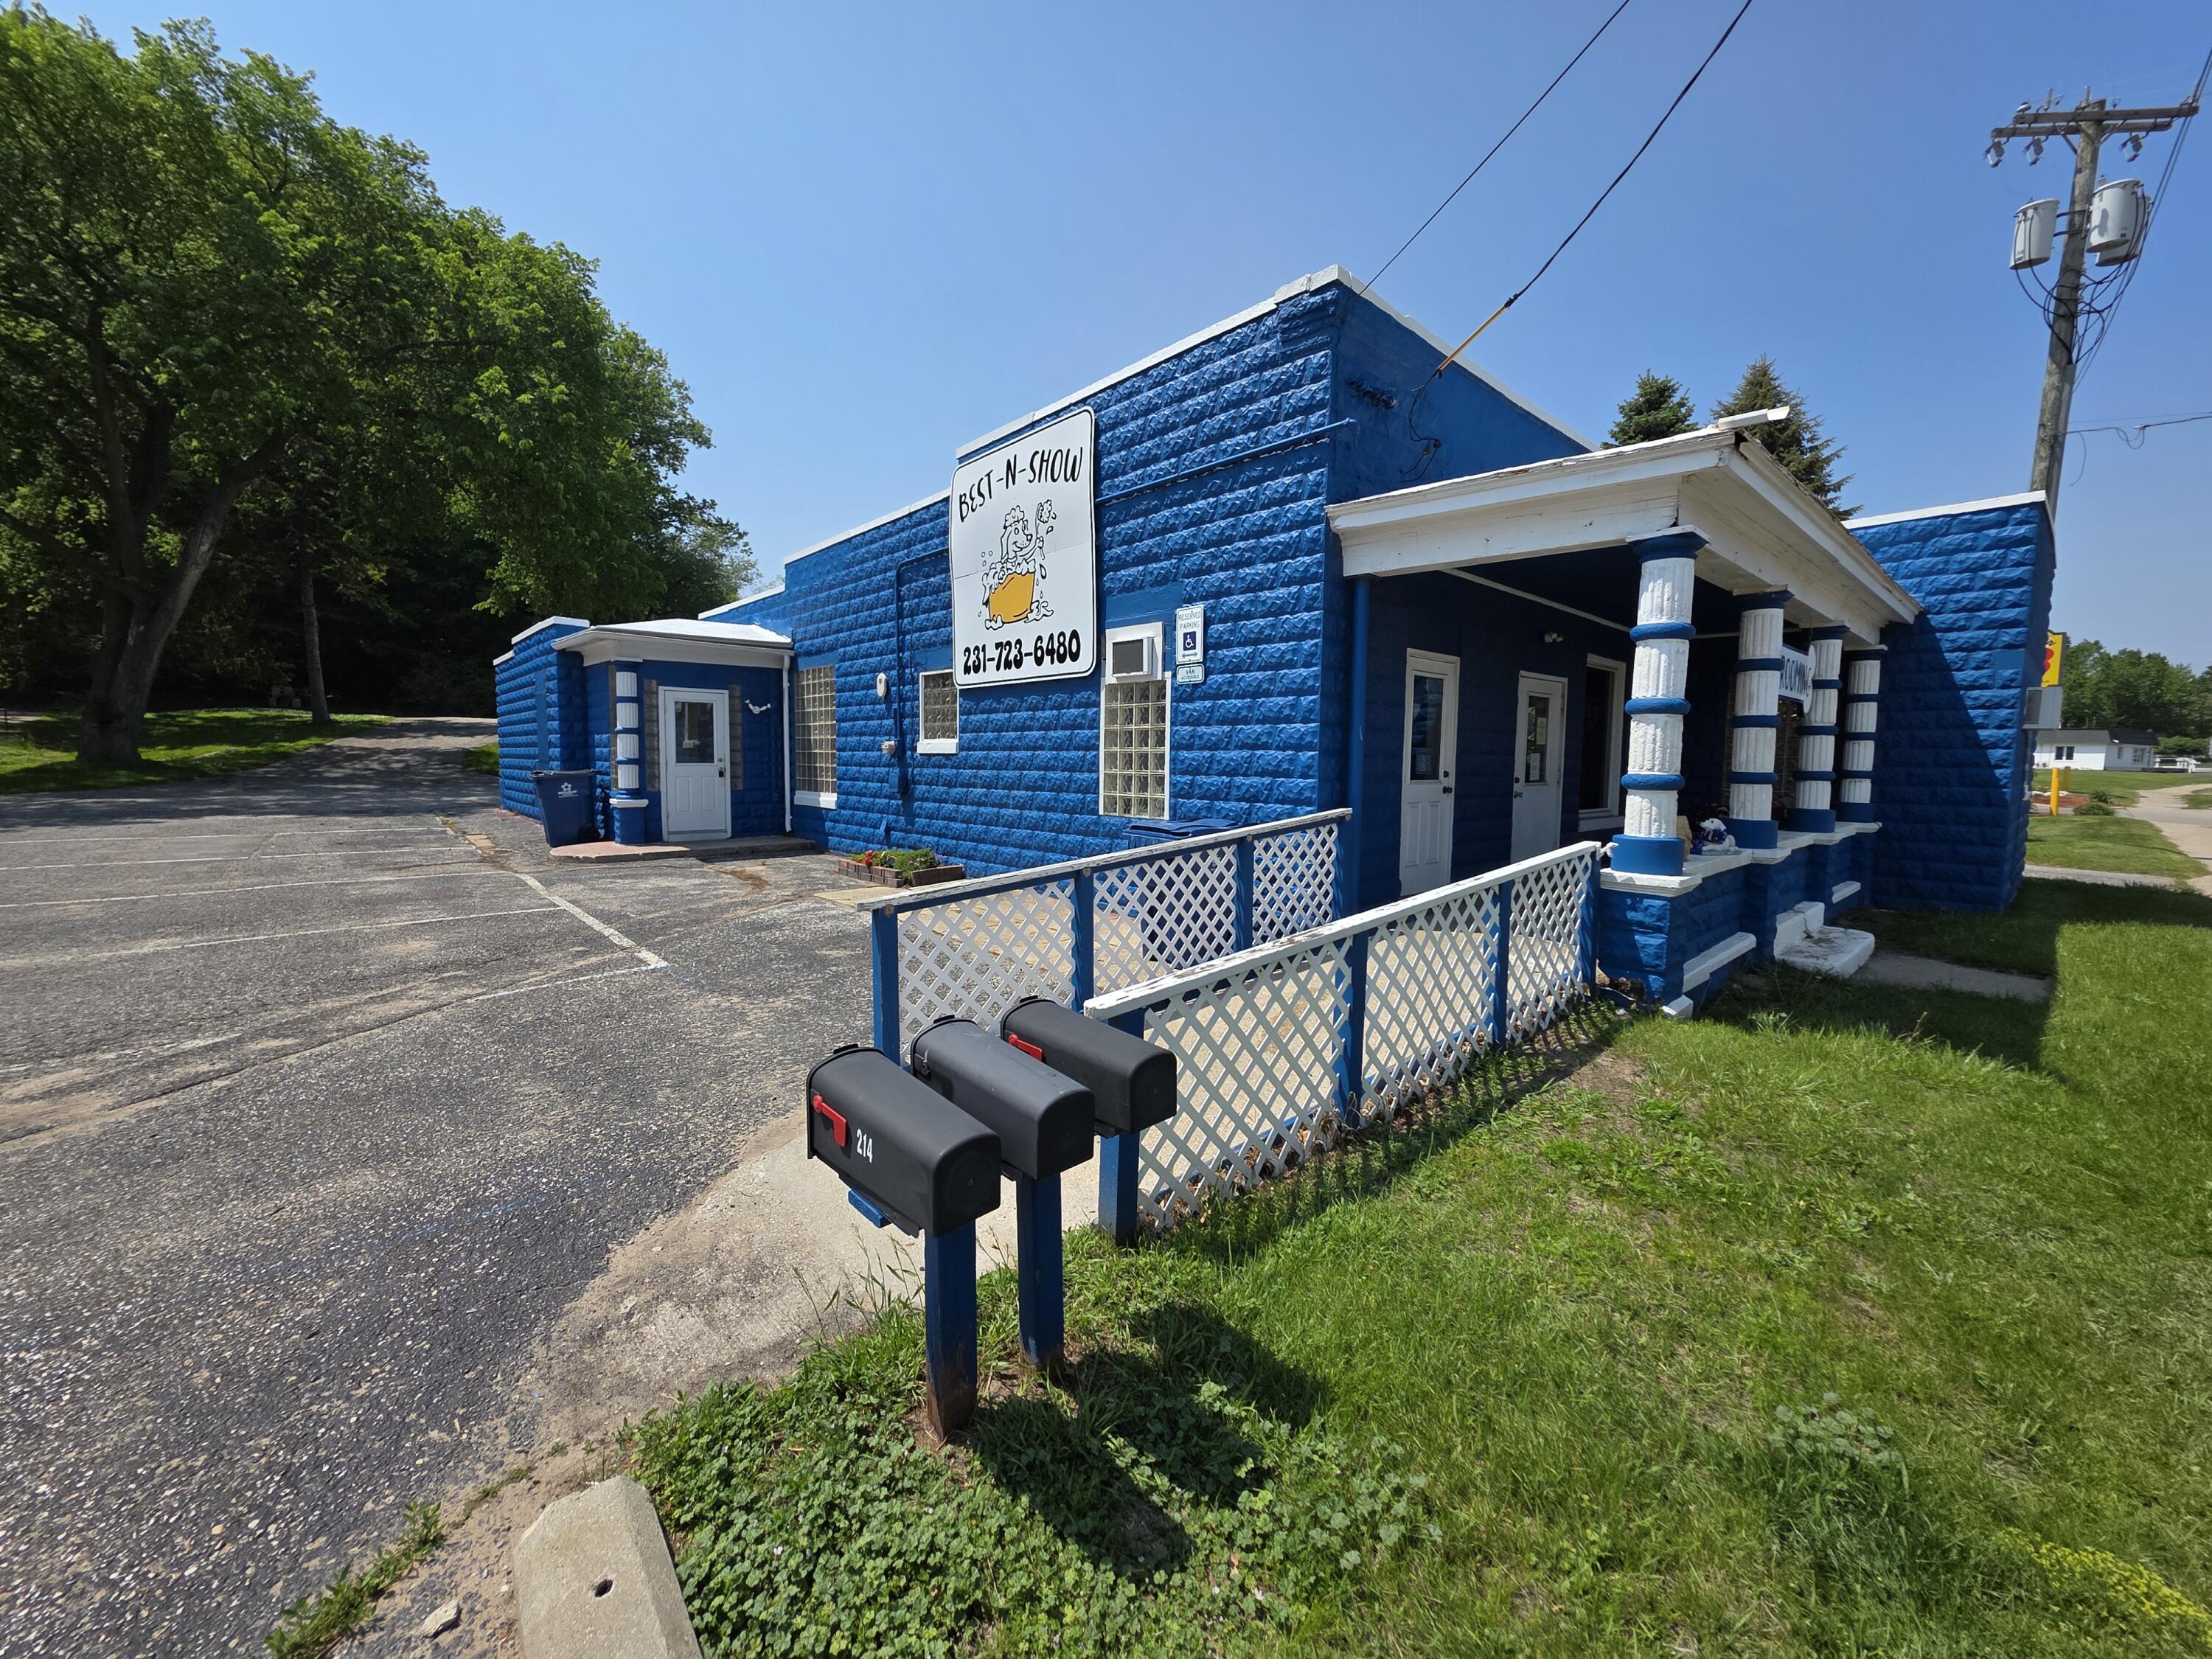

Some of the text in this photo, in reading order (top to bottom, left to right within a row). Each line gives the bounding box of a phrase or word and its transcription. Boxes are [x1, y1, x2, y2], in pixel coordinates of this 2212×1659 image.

[959, 446, 1083, 523] BEST-N-SHOW
[1179, 611, 1201, 621] RESERVED
[1180, 622, 1200, 630] PARKING
[963, 629, 1082, 675] 231-723-6480
[1779, 655, 1812, 698] ROOMING
[856, 1128, 873, 1163] 214
